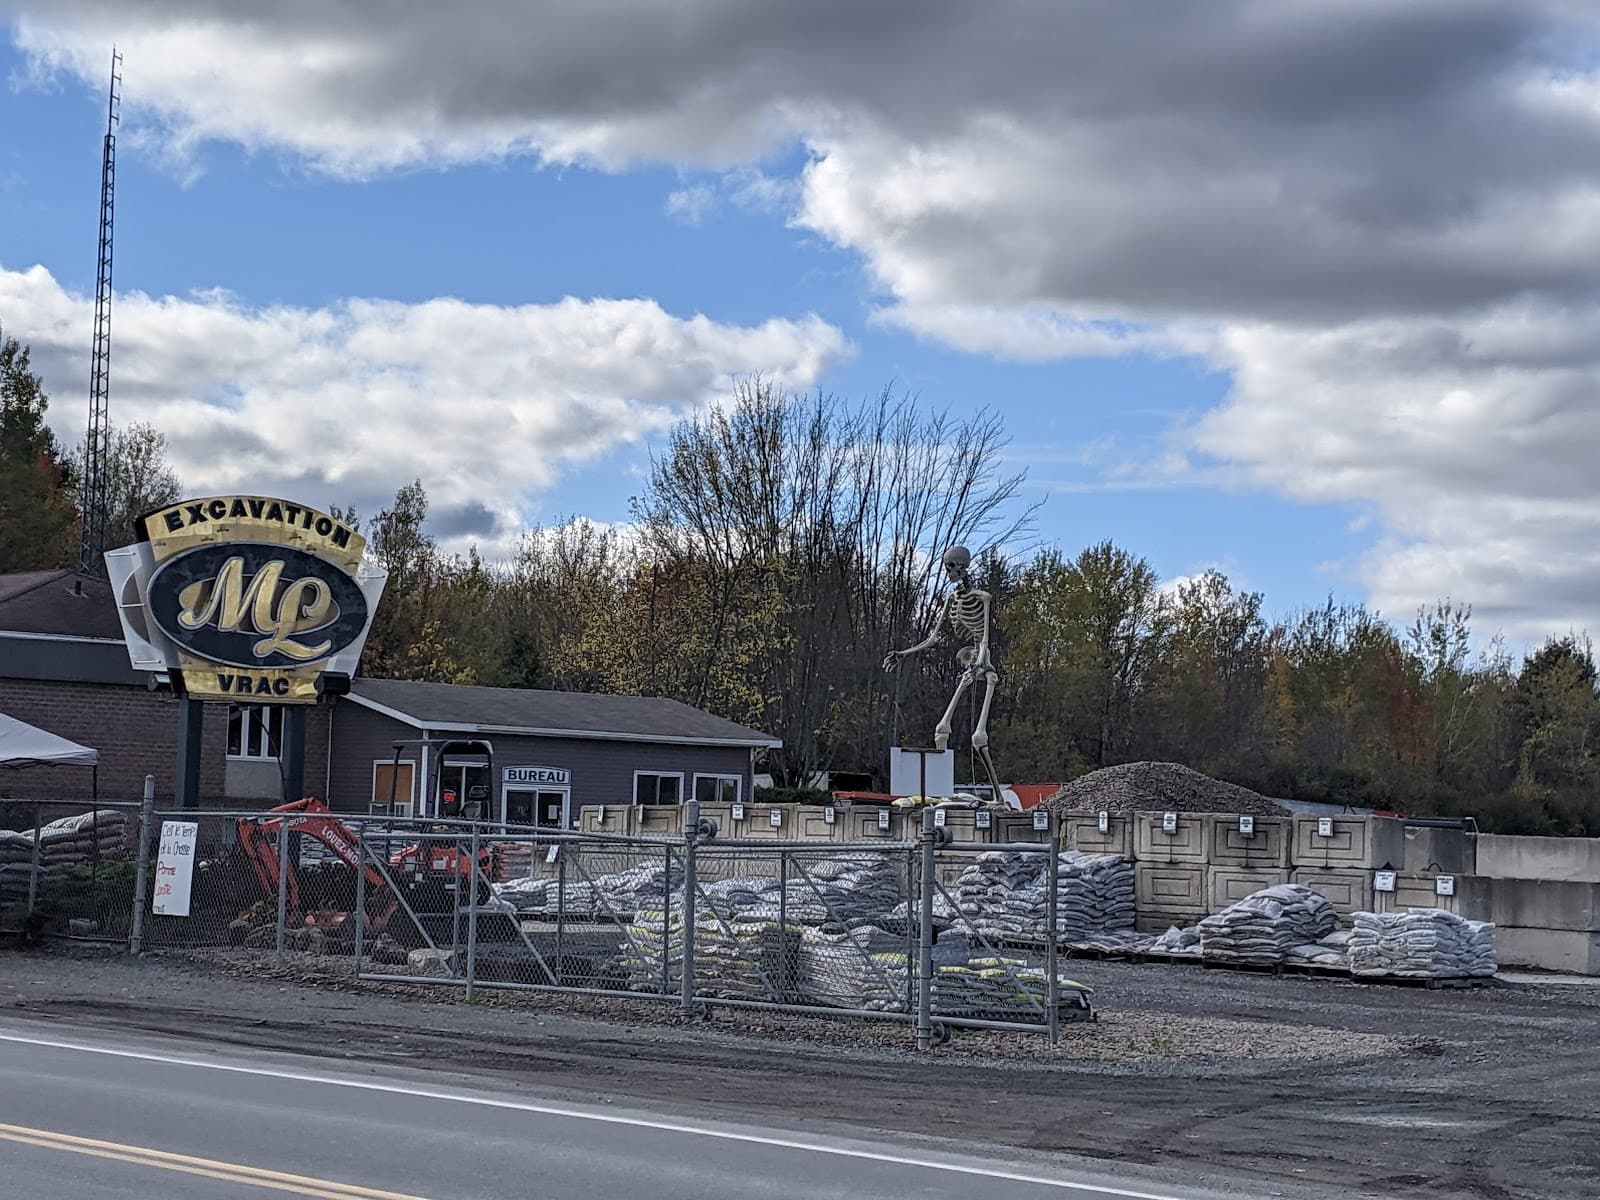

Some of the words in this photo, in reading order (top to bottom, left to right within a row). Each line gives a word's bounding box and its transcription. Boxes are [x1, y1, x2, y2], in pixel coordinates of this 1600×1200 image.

[163, 499, 352, 549] EXCAVATION
[217, 673, 290, 695] VRAC
[508, 769, 566, 782] BUREAU
[321, 825, 359, 865] LOUEZ-MO
